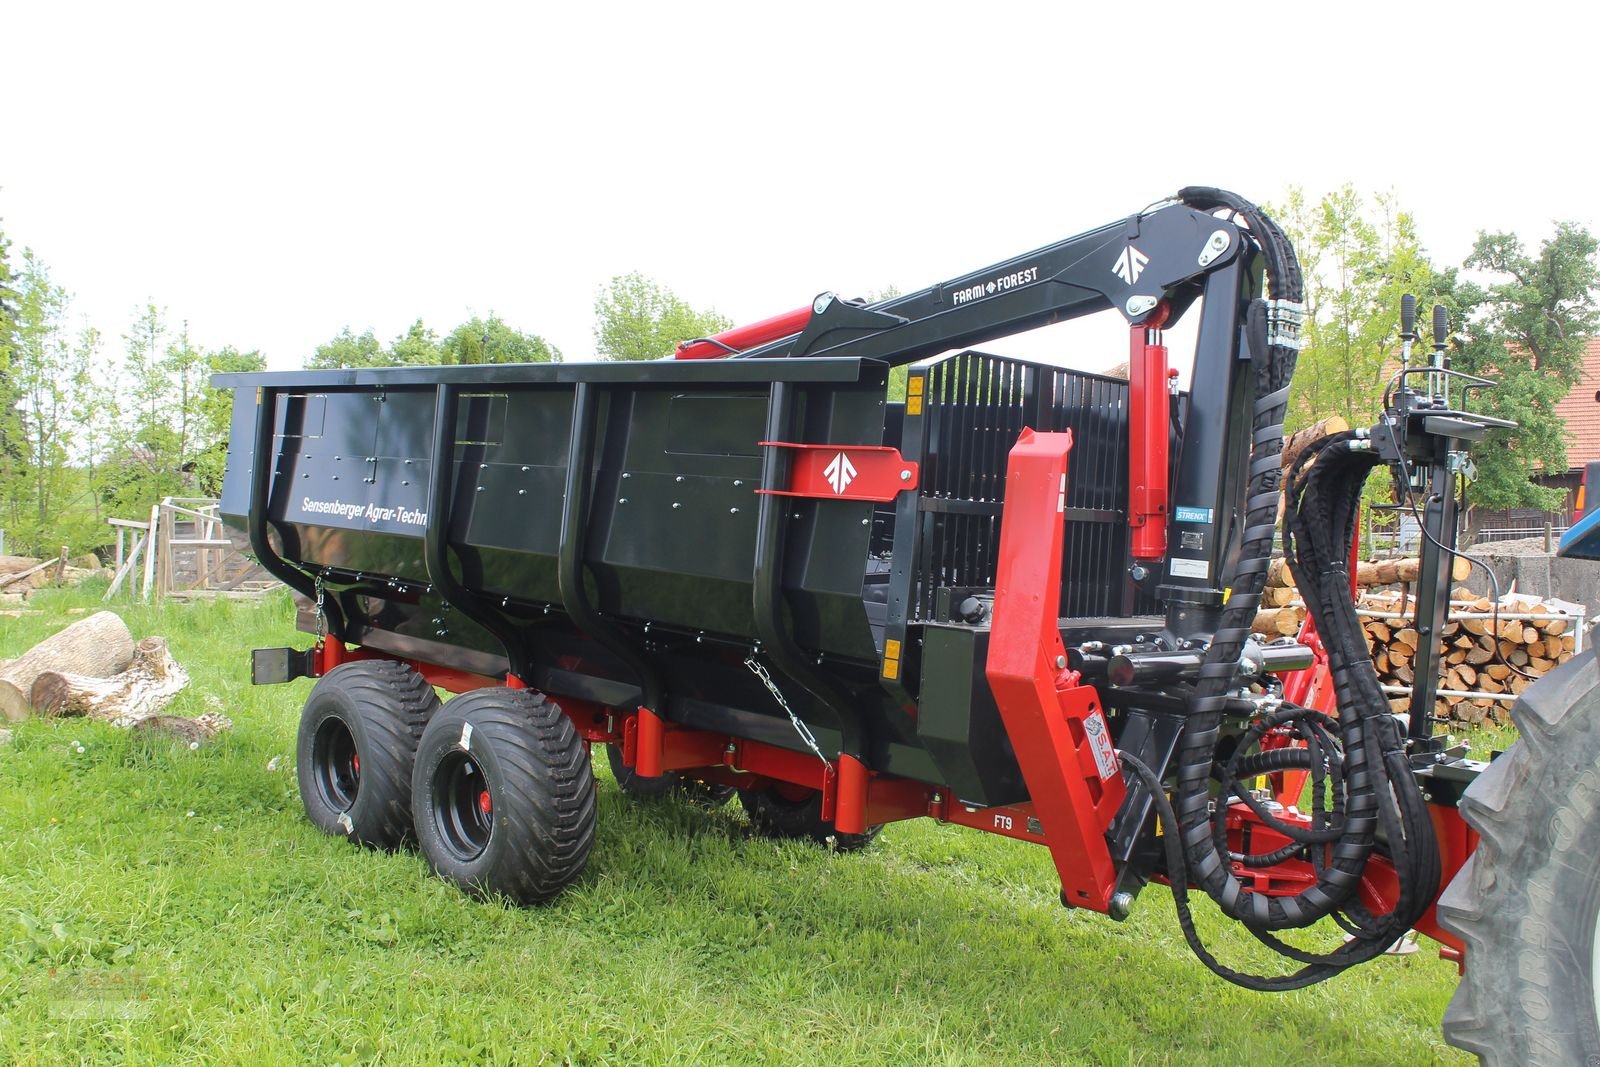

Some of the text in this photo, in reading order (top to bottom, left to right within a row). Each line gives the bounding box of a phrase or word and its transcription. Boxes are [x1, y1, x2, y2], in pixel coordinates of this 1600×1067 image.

[953, 266, 1038, 305] FARMI FOREST
[302, 497, 365, 519] Sensenberger
[1177, 511, 1205, 521] STRENX
[994, 814, 1013, 830] FT9
